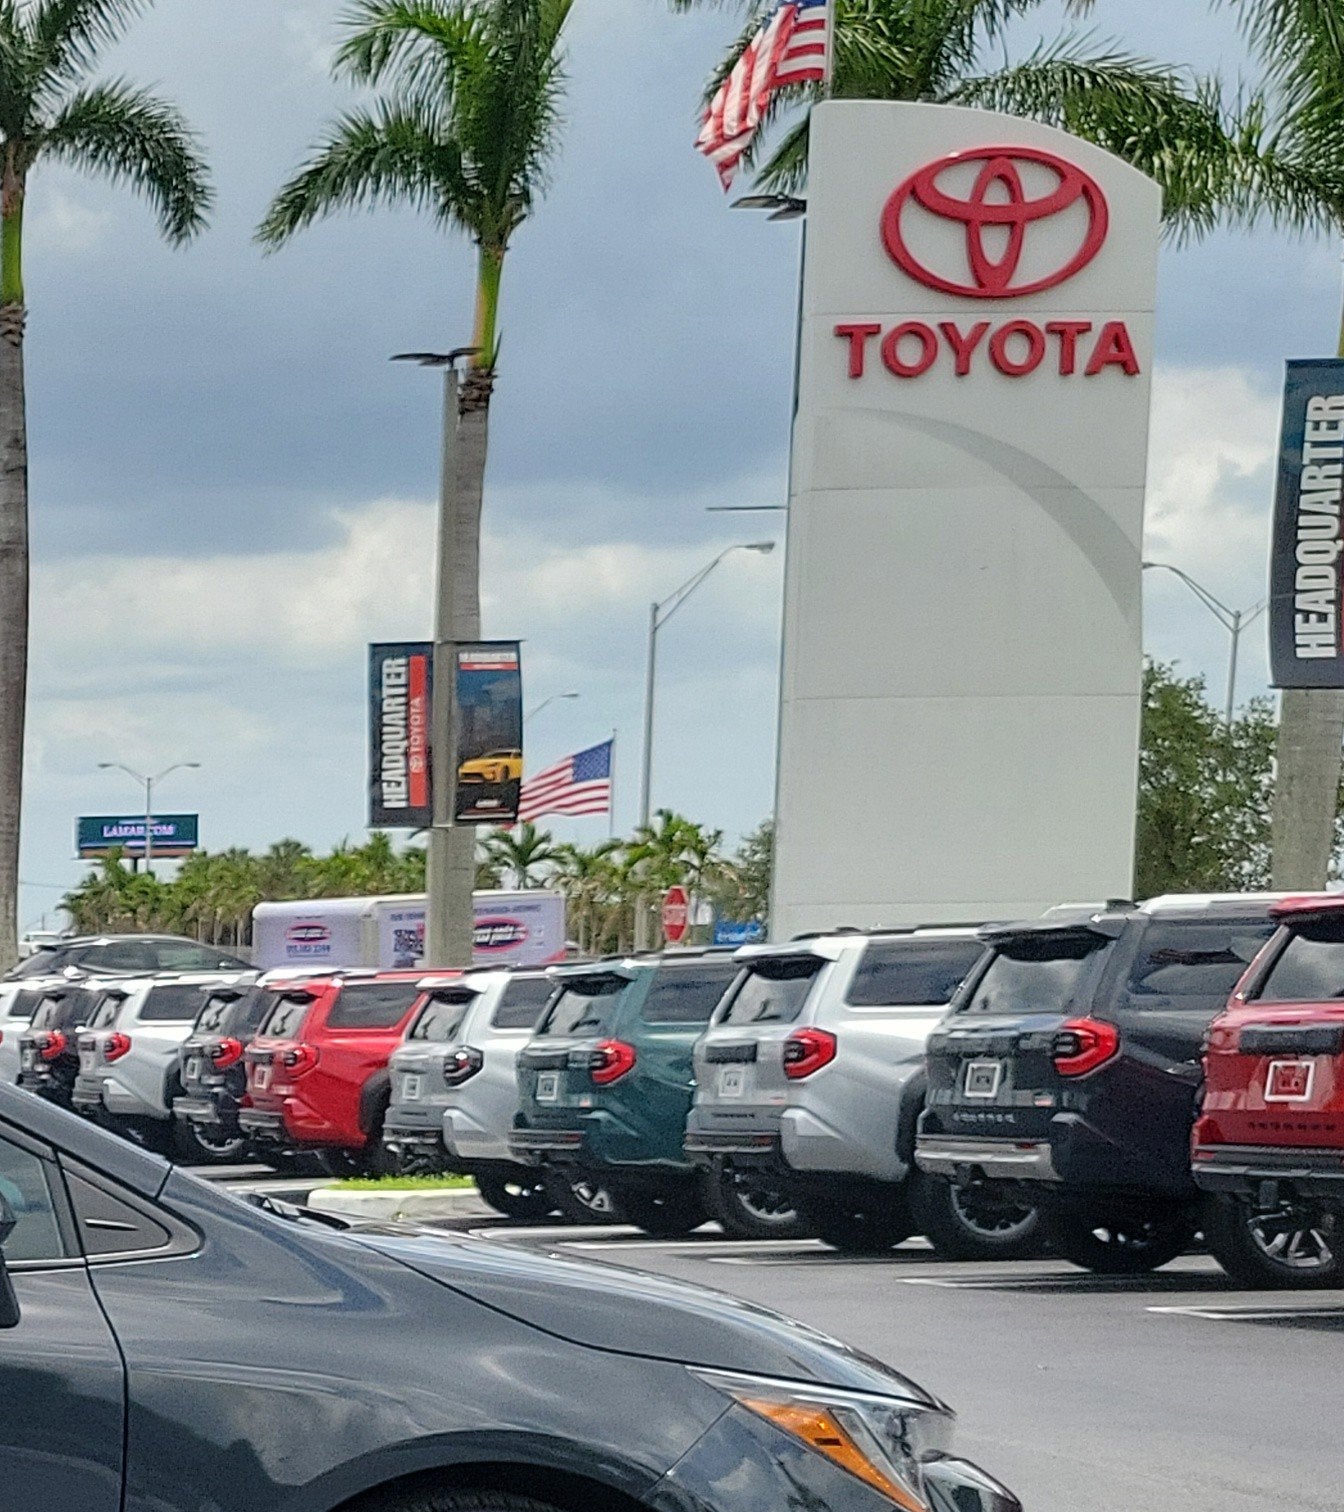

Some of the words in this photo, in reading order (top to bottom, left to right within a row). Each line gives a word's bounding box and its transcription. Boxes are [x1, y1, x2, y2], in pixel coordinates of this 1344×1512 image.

[834, 320, 1141, 379] TOYOTA
[1294, 395, 1344, 659] HEADQUARTER
[381, 657, 409, 809] HEADQUARTER
